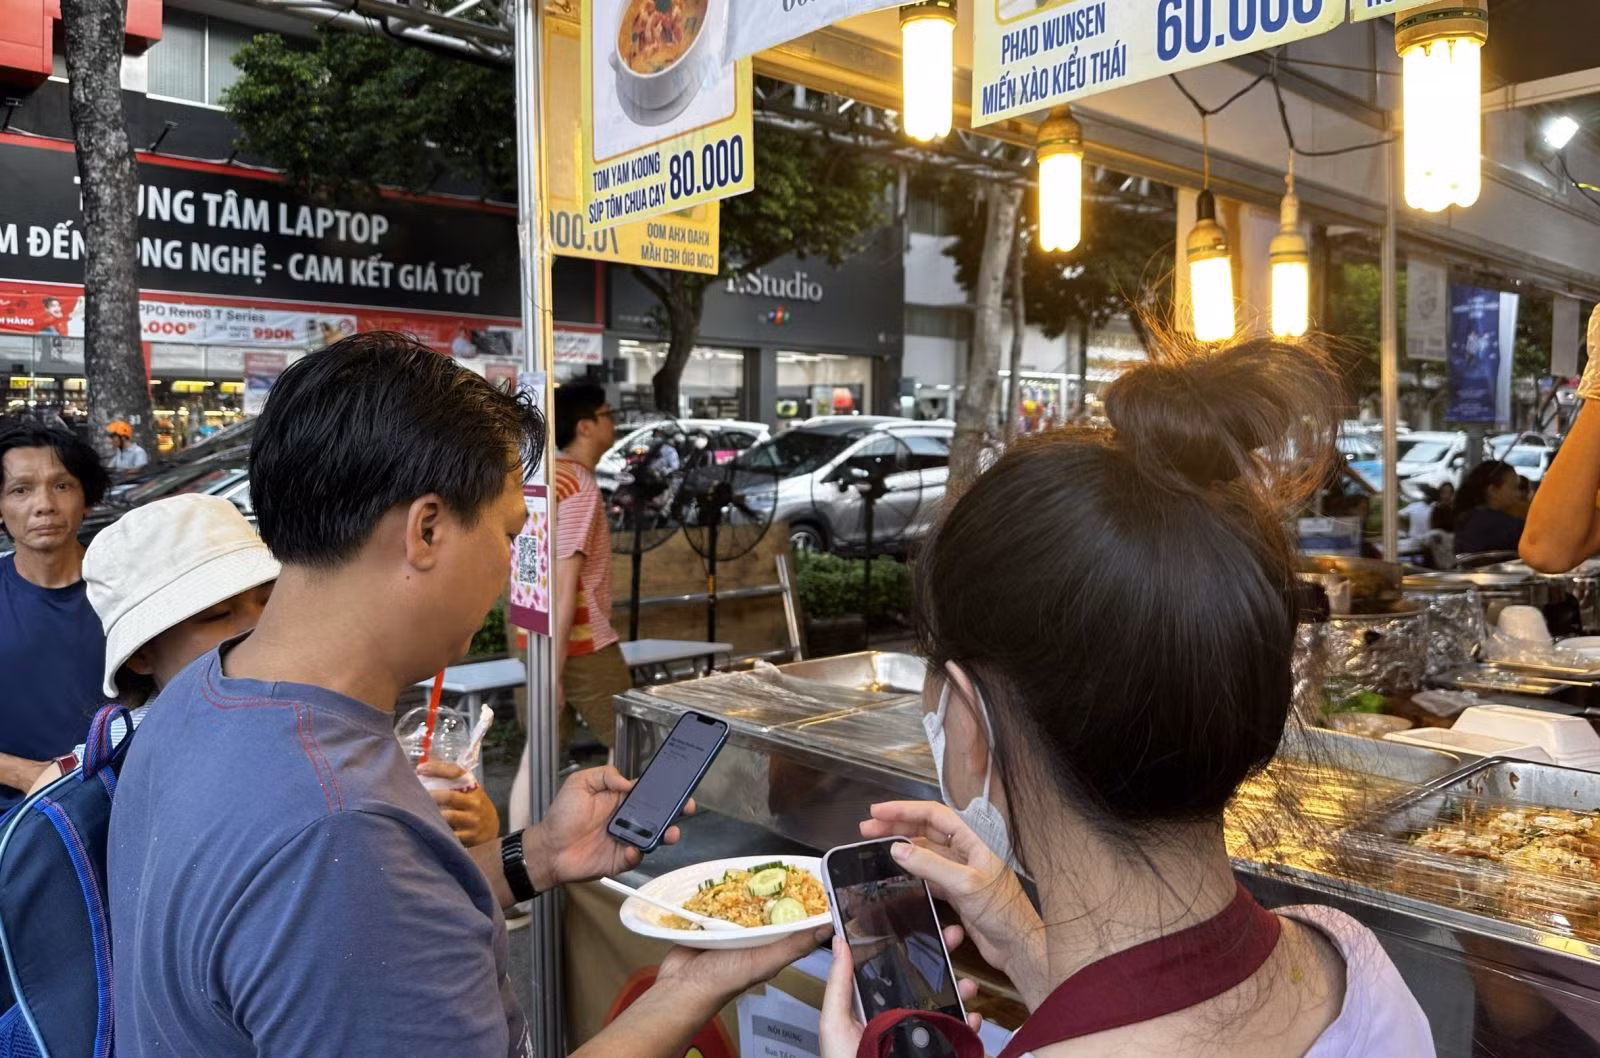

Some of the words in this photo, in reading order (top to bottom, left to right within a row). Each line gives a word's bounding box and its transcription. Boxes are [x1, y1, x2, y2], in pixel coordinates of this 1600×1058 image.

[1001, 25, 1039, 65] PHAD
[1042, 2, 1106, 52] WUNSEN
[982, 70, 1017, 116] MIẾN
[1019, 65, 1049, 105] XÀO
[1052, 45, 1087, 96] KIỂU
[1090, 39, 1127, 85] THÁI
[592, 168, 610, 192] TOM
[611, 159, 630, 187] YAM
[631, 151, 661, 180] KOONG
[669, 134, 744, 200] 80.000
[202, 189, 270, 232] TÂM
[278, 202, 389, 245] LAPTOP
[589, 198, 604, 224] SÚP
[624, 188, 648, 214] CHUA
[649, 182, 666, 208] CAY
[190, 241, 267, 285] NGHỆ
[288, 253, 344, 284] CAM
[350, 253, 394, 289] KẾT
[399, 261, 438, 292] GIÁ
[443, 263, 483, 296] TỐT
[169, 305, 211, 319] Reno8
[216, 308, 222, 319] T
[226, 309, 266, 323] Series
